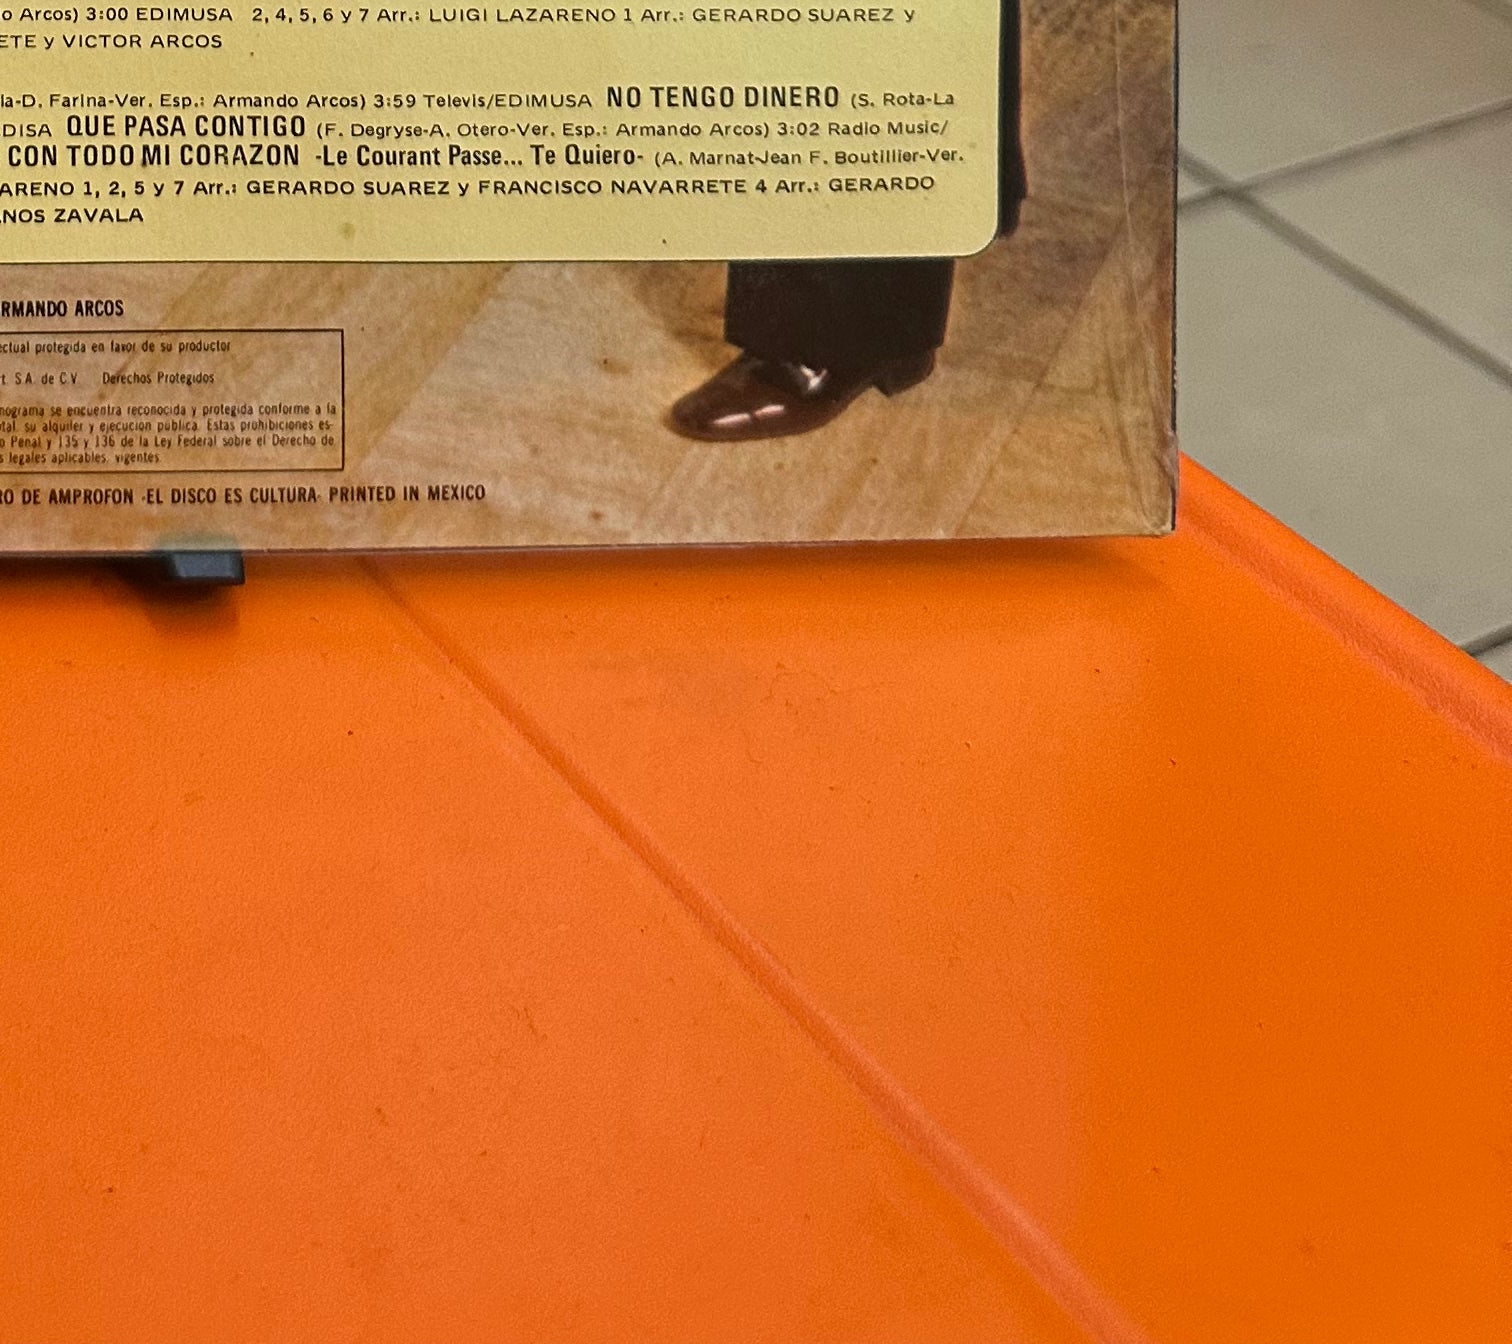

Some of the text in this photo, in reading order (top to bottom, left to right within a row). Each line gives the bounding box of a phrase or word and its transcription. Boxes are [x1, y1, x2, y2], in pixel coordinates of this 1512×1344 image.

[43, 35, 55, 51] y
[62, 33, 142, 49] VICTOR
[148, 33, 224, 50] ARCOS
[607, 85, 840, 109] NO TENGO DINERO
[66, 114, 306, 138] QUE PASA CONTIGO
[7, 144, 58, 169] CON
[65, 143, 135, 168] TODO
[140, 143, 170, 170] MI
[179, 143, 299, 167] CORAZON
[315, 144, 348, 167] -Le
[356, 144, 441, 168] Courant
[448, 143, 523, 167] Passe...
[529, 143, 556, 166] Te
[564, 143, 644, 166] Quiero-
[53, 207, 144, 224] ZAVALA
[74, 299, 124, 317] ARCOS
[22, 489, 41, 505] DE
[49, 488, 133, 505] AMPROFON
[171, 488, 217, 505] DISCO
[224, 488, 242, 506] ES
[329, 486, 396, 503] PRINTED
[403, 486, 419, 501] IN
[428, 484, 486, 502] MEXICO
